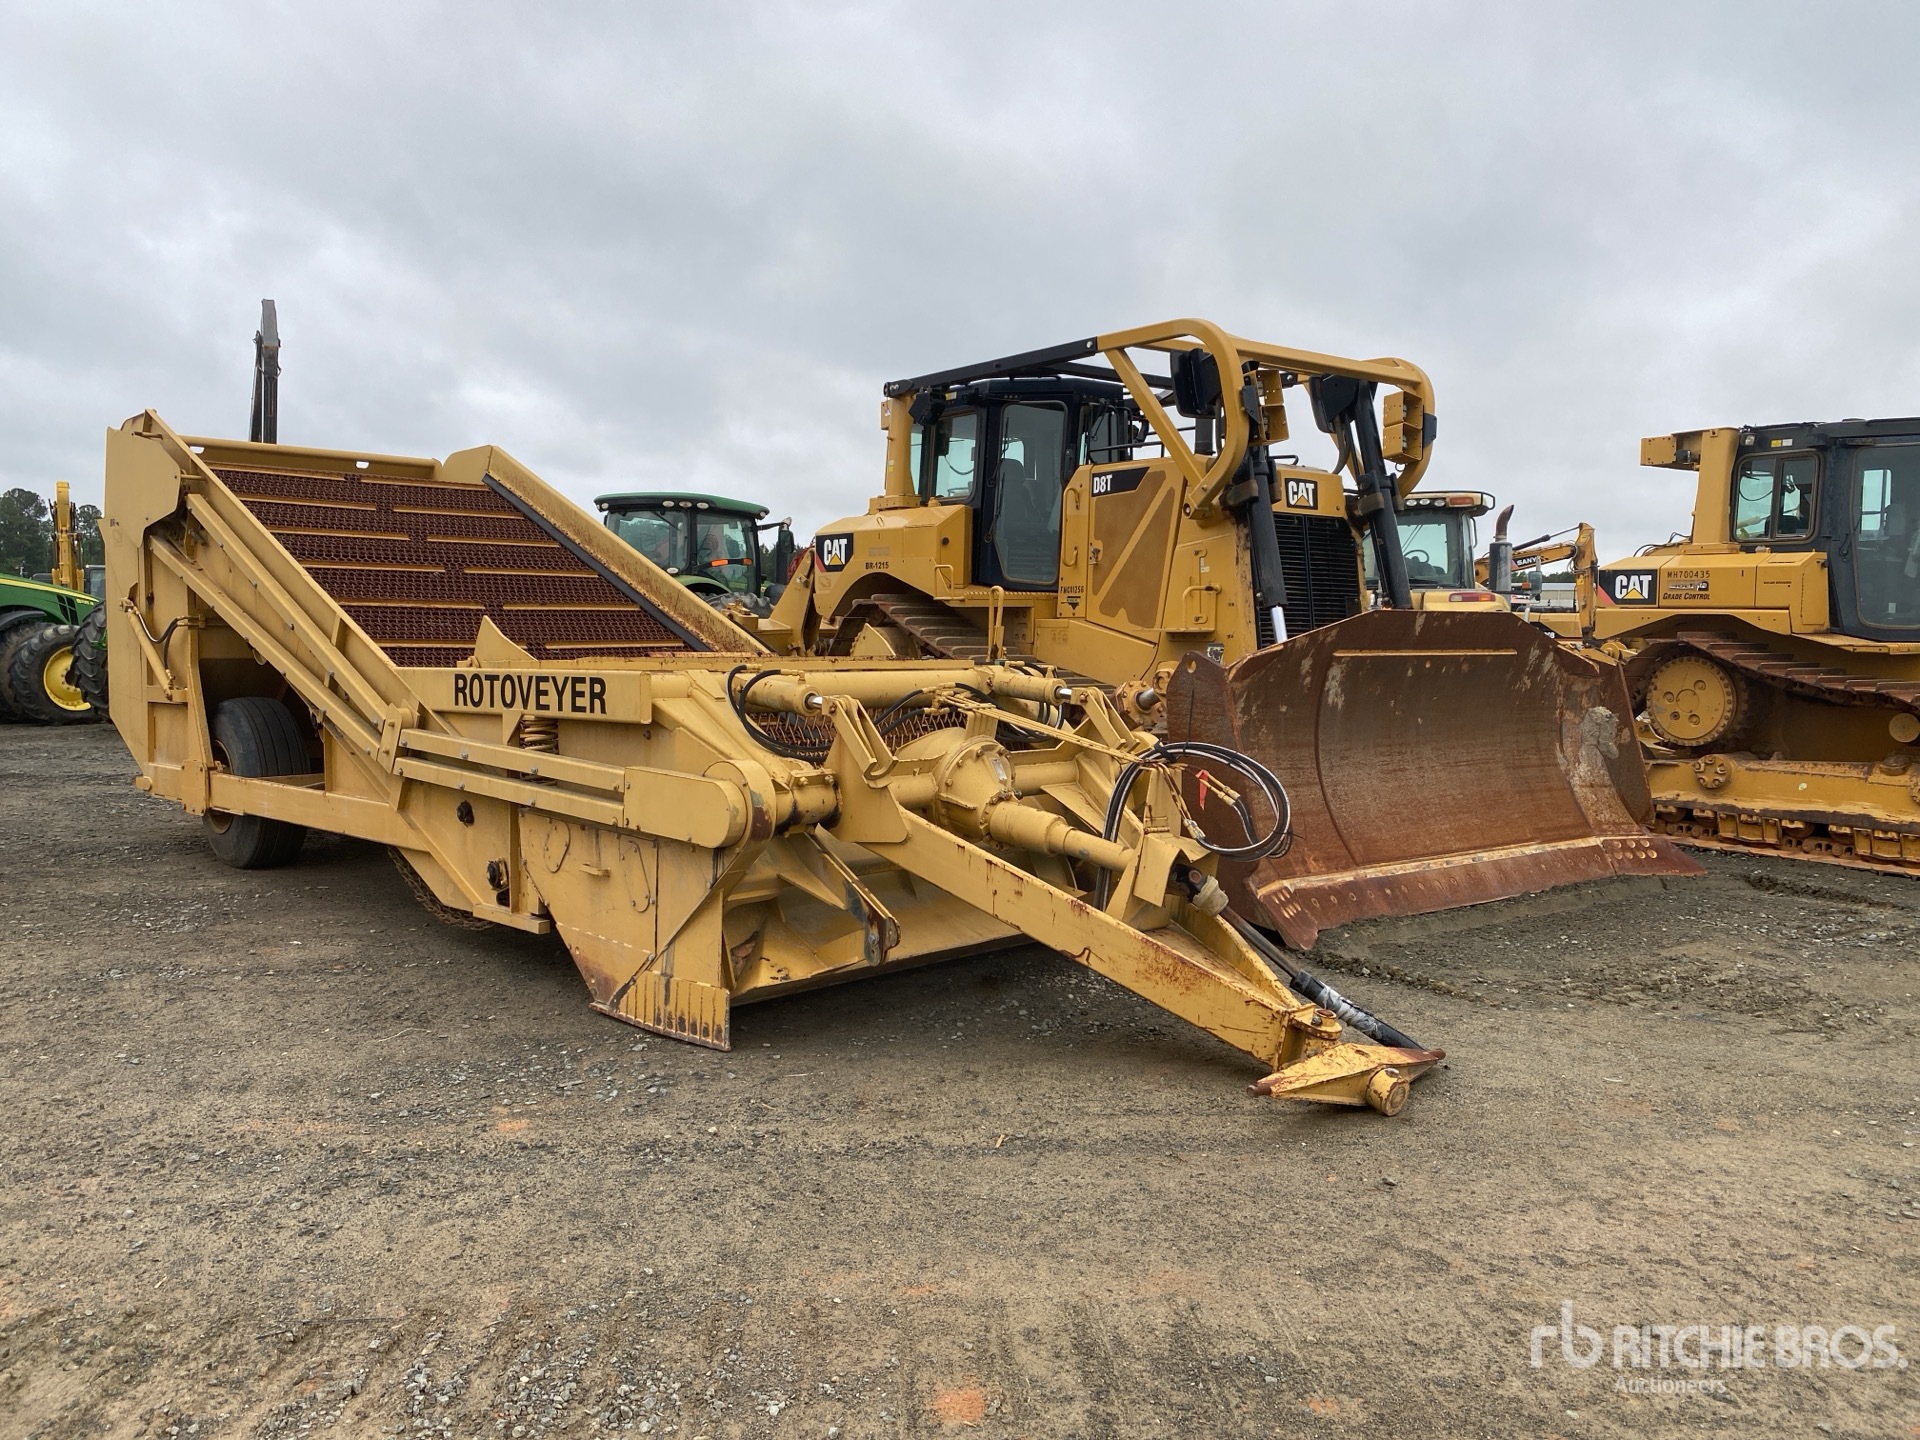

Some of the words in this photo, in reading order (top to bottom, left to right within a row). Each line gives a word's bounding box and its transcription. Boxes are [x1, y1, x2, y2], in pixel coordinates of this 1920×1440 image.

[1093, 474, 1113, 494] D8T
[1288, 480, 1315, 507] CAT
[823, 538, 848, 566] CAT
[1516, 556, 1537, 566] SANY
[865, 561, 890, 570] BR-1215
[1667, 570, 1711, 579] MH700435
[1614, 574, 1652, 600] CAT
[454, 672, 608, 715] ROTOVEYER
